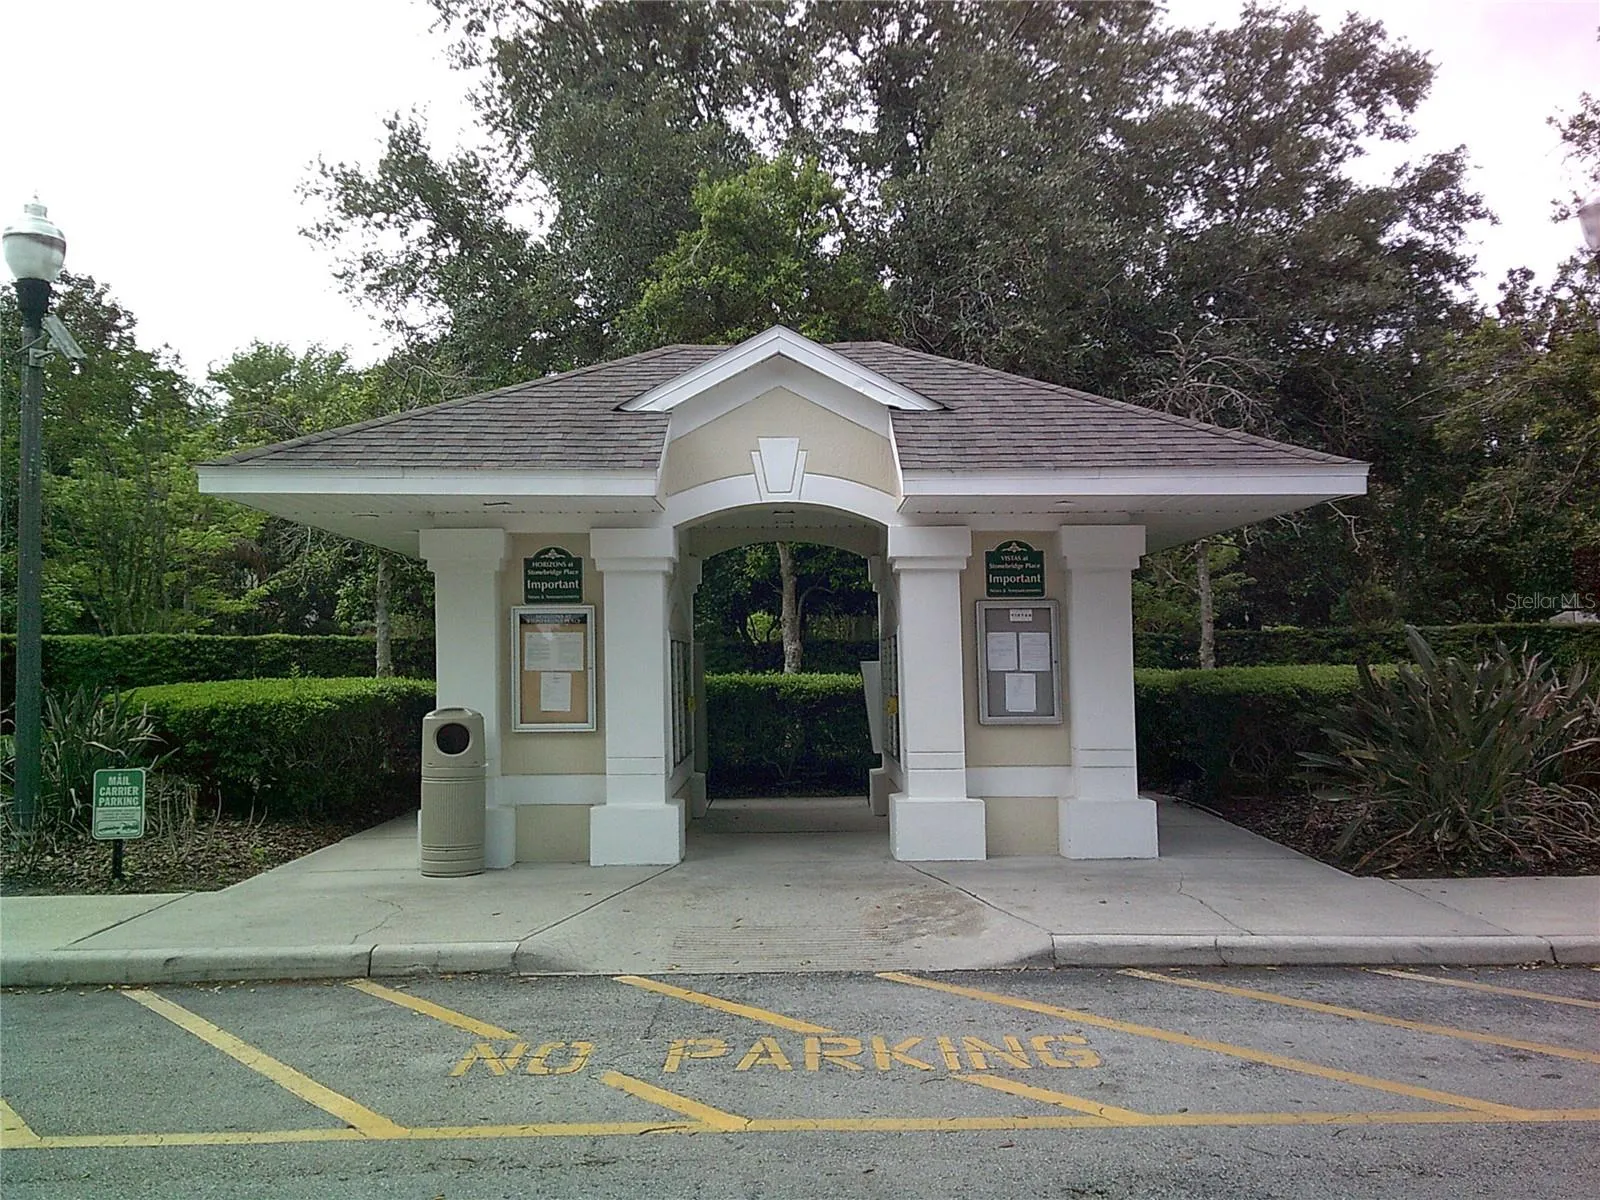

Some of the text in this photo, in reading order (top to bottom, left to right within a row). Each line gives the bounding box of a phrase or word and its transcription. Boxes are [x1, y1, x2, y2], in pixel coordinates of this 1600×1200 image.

[527, 579, 580, 593] Important
[989, 573, 1041, 587] Important
[108, 776, 131, 786] MAIL
[99, 786, 139, 796] CARRIER
[98, 797, 139, 807] PARKING
[448, 1034, 1101, 1077] NO PARKING
